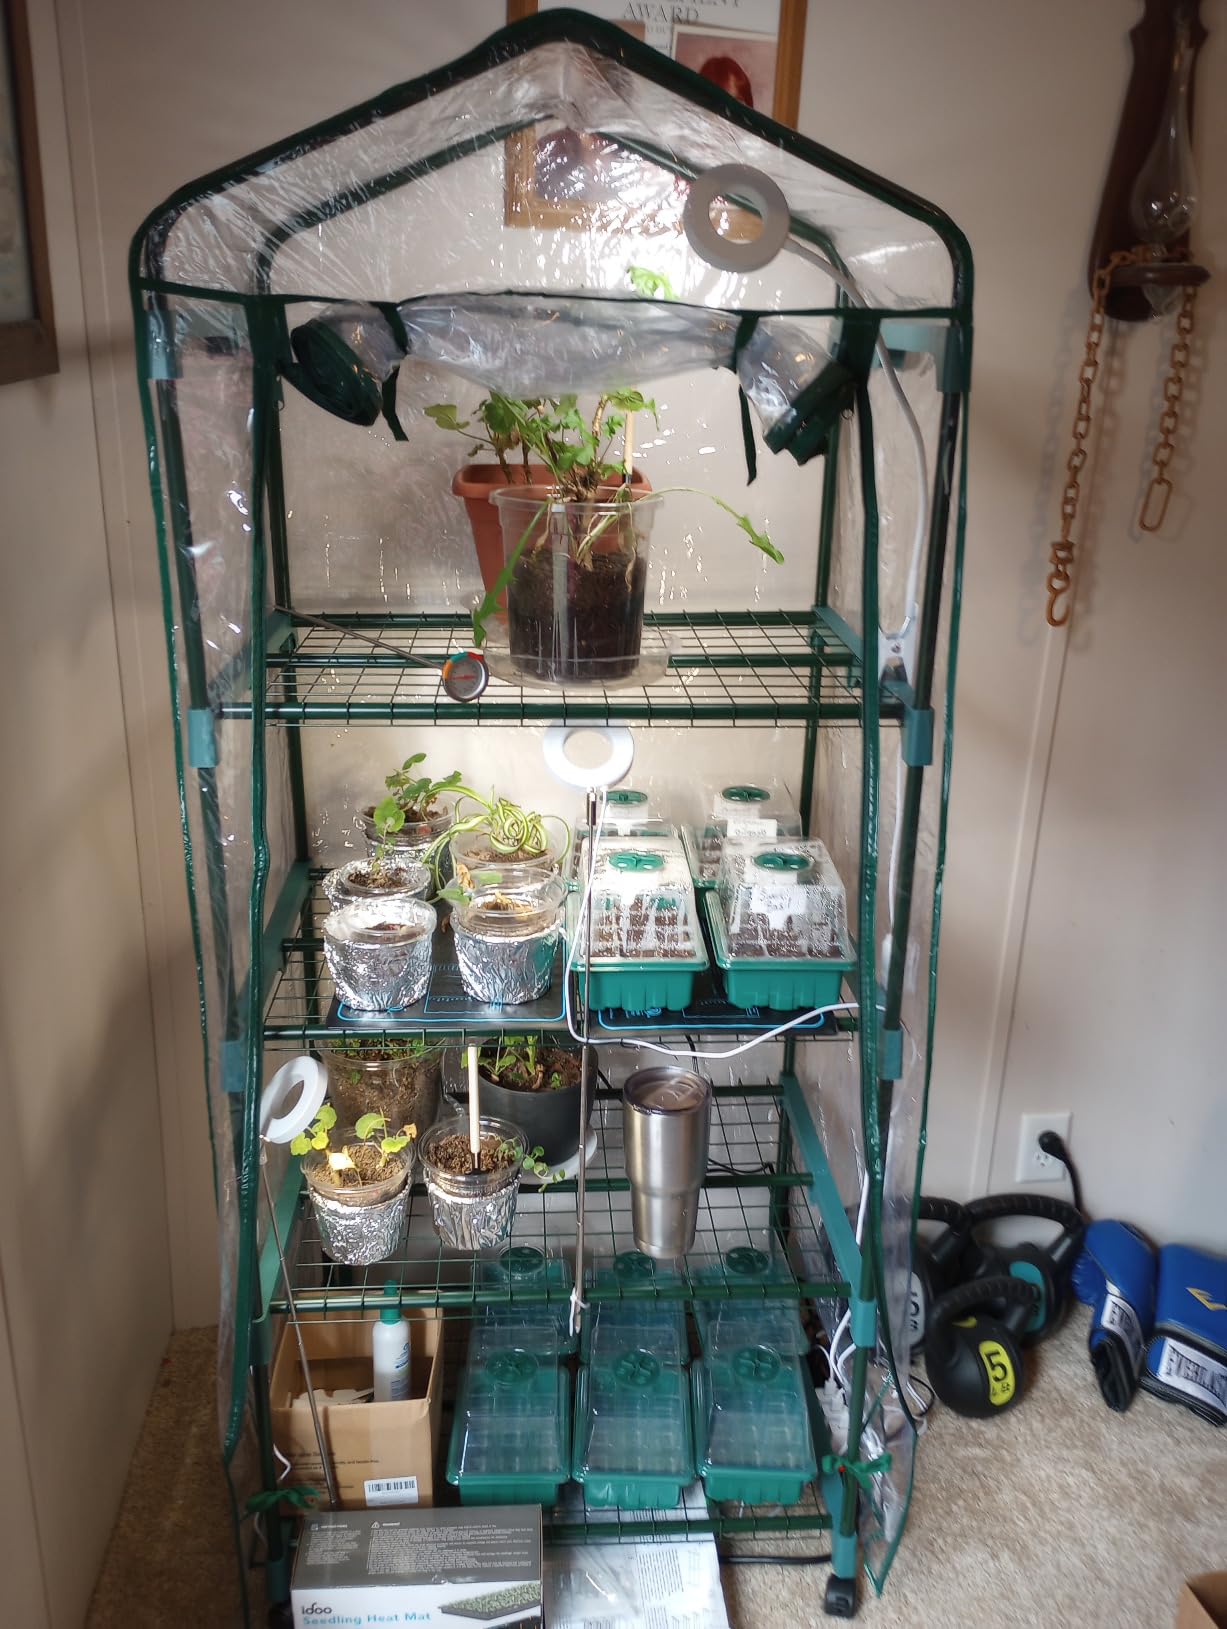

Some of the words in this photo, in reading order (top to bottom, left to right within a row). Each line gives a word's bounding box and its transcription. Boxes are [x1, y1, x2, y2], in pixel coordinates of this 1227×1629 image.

[623, 2, 699, 24] AWARD
[984, 1349, 1007, 1382] 5
[303, 1614, 362, 1625] Seedling
[367, 1613, 398, 1622] Heat
[404, 1611, 431, 1621] Mat
